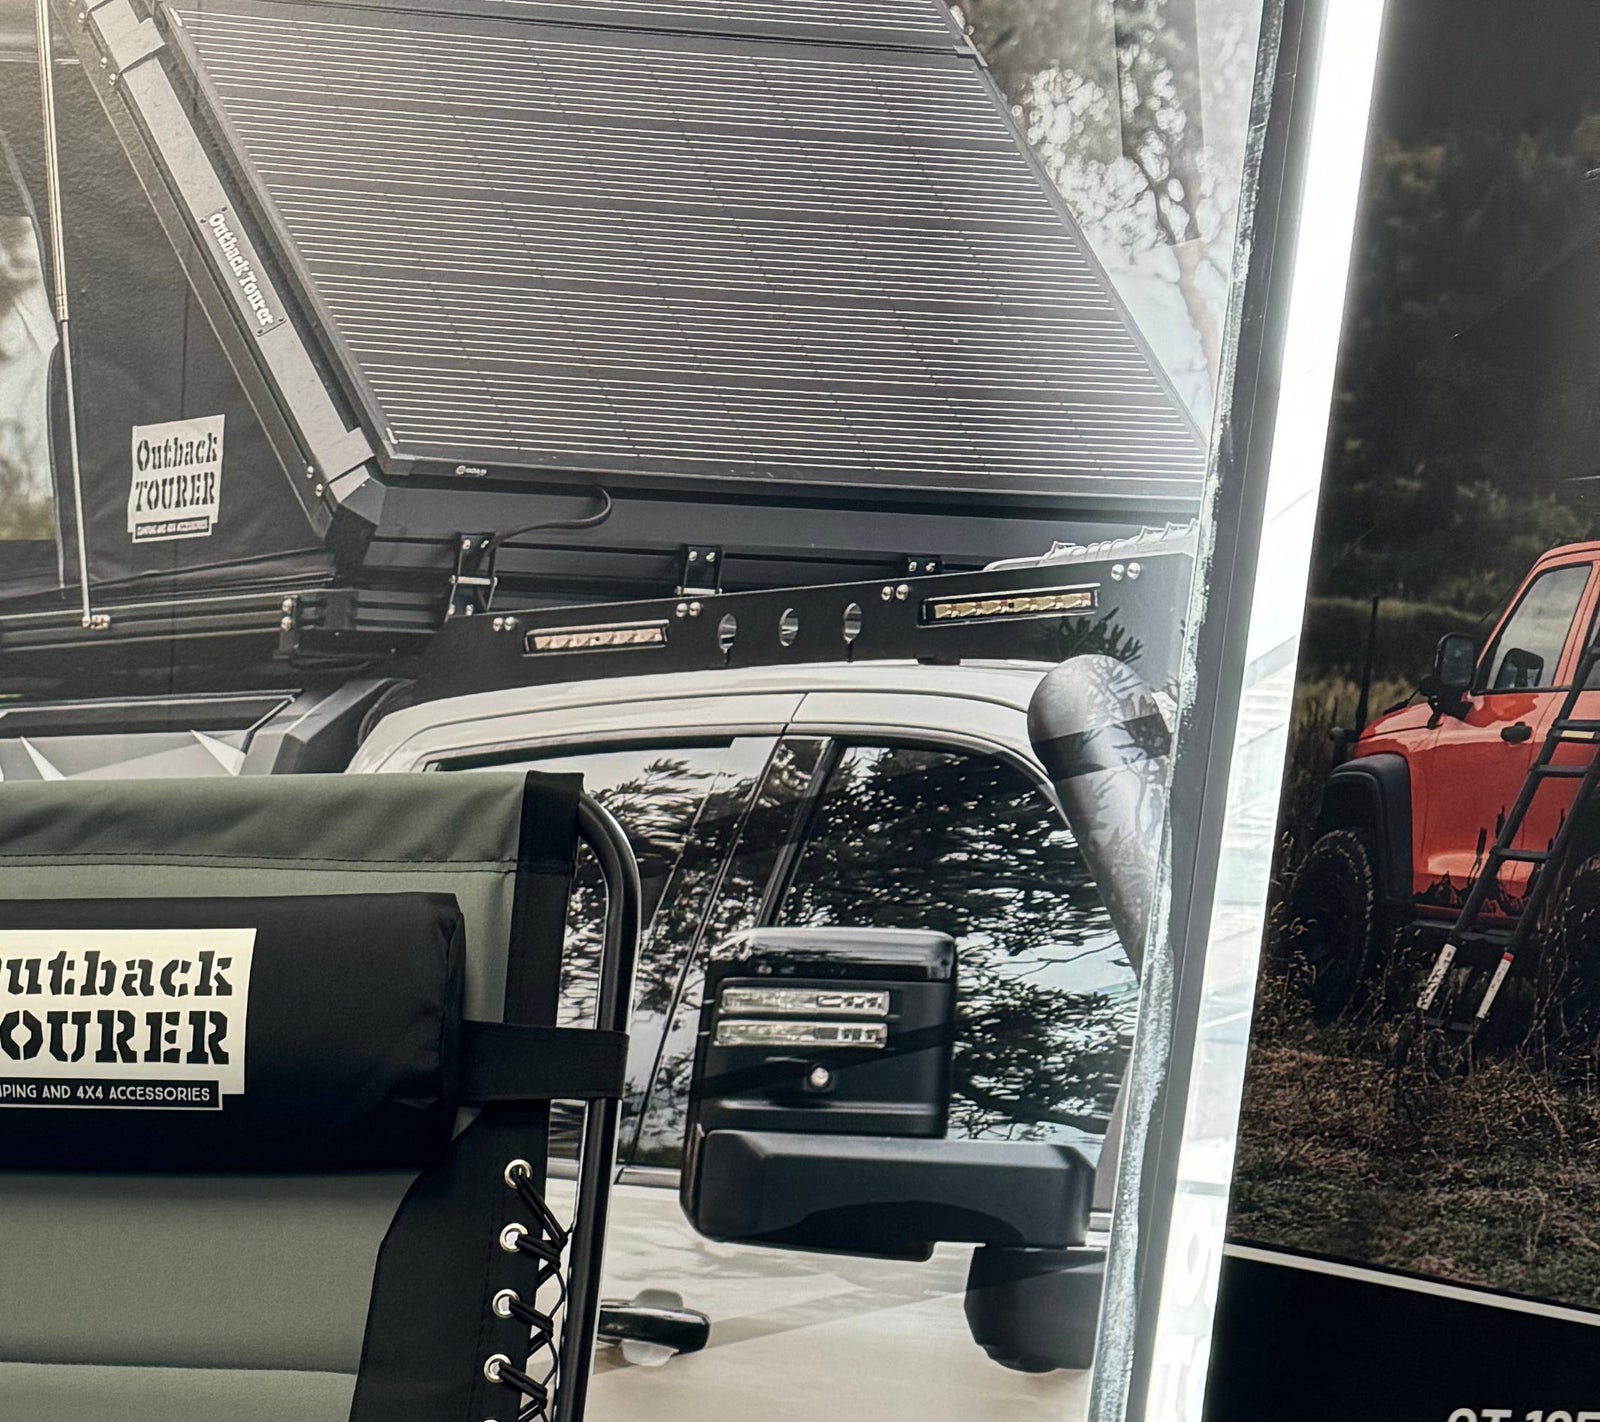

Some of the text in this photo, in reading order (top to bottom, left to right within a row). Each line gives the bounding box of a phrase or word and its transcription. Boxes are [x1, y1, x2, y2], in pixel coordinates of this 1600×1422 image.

[136, 432, 217, 471] Outback
[135, 472, 215, 512] TOURER
[42, 1085, 71, 1100] AND
[76, 1085, 104, 1100] 4X4
[109, 1085, 211, 1102] ACCESSORIES
